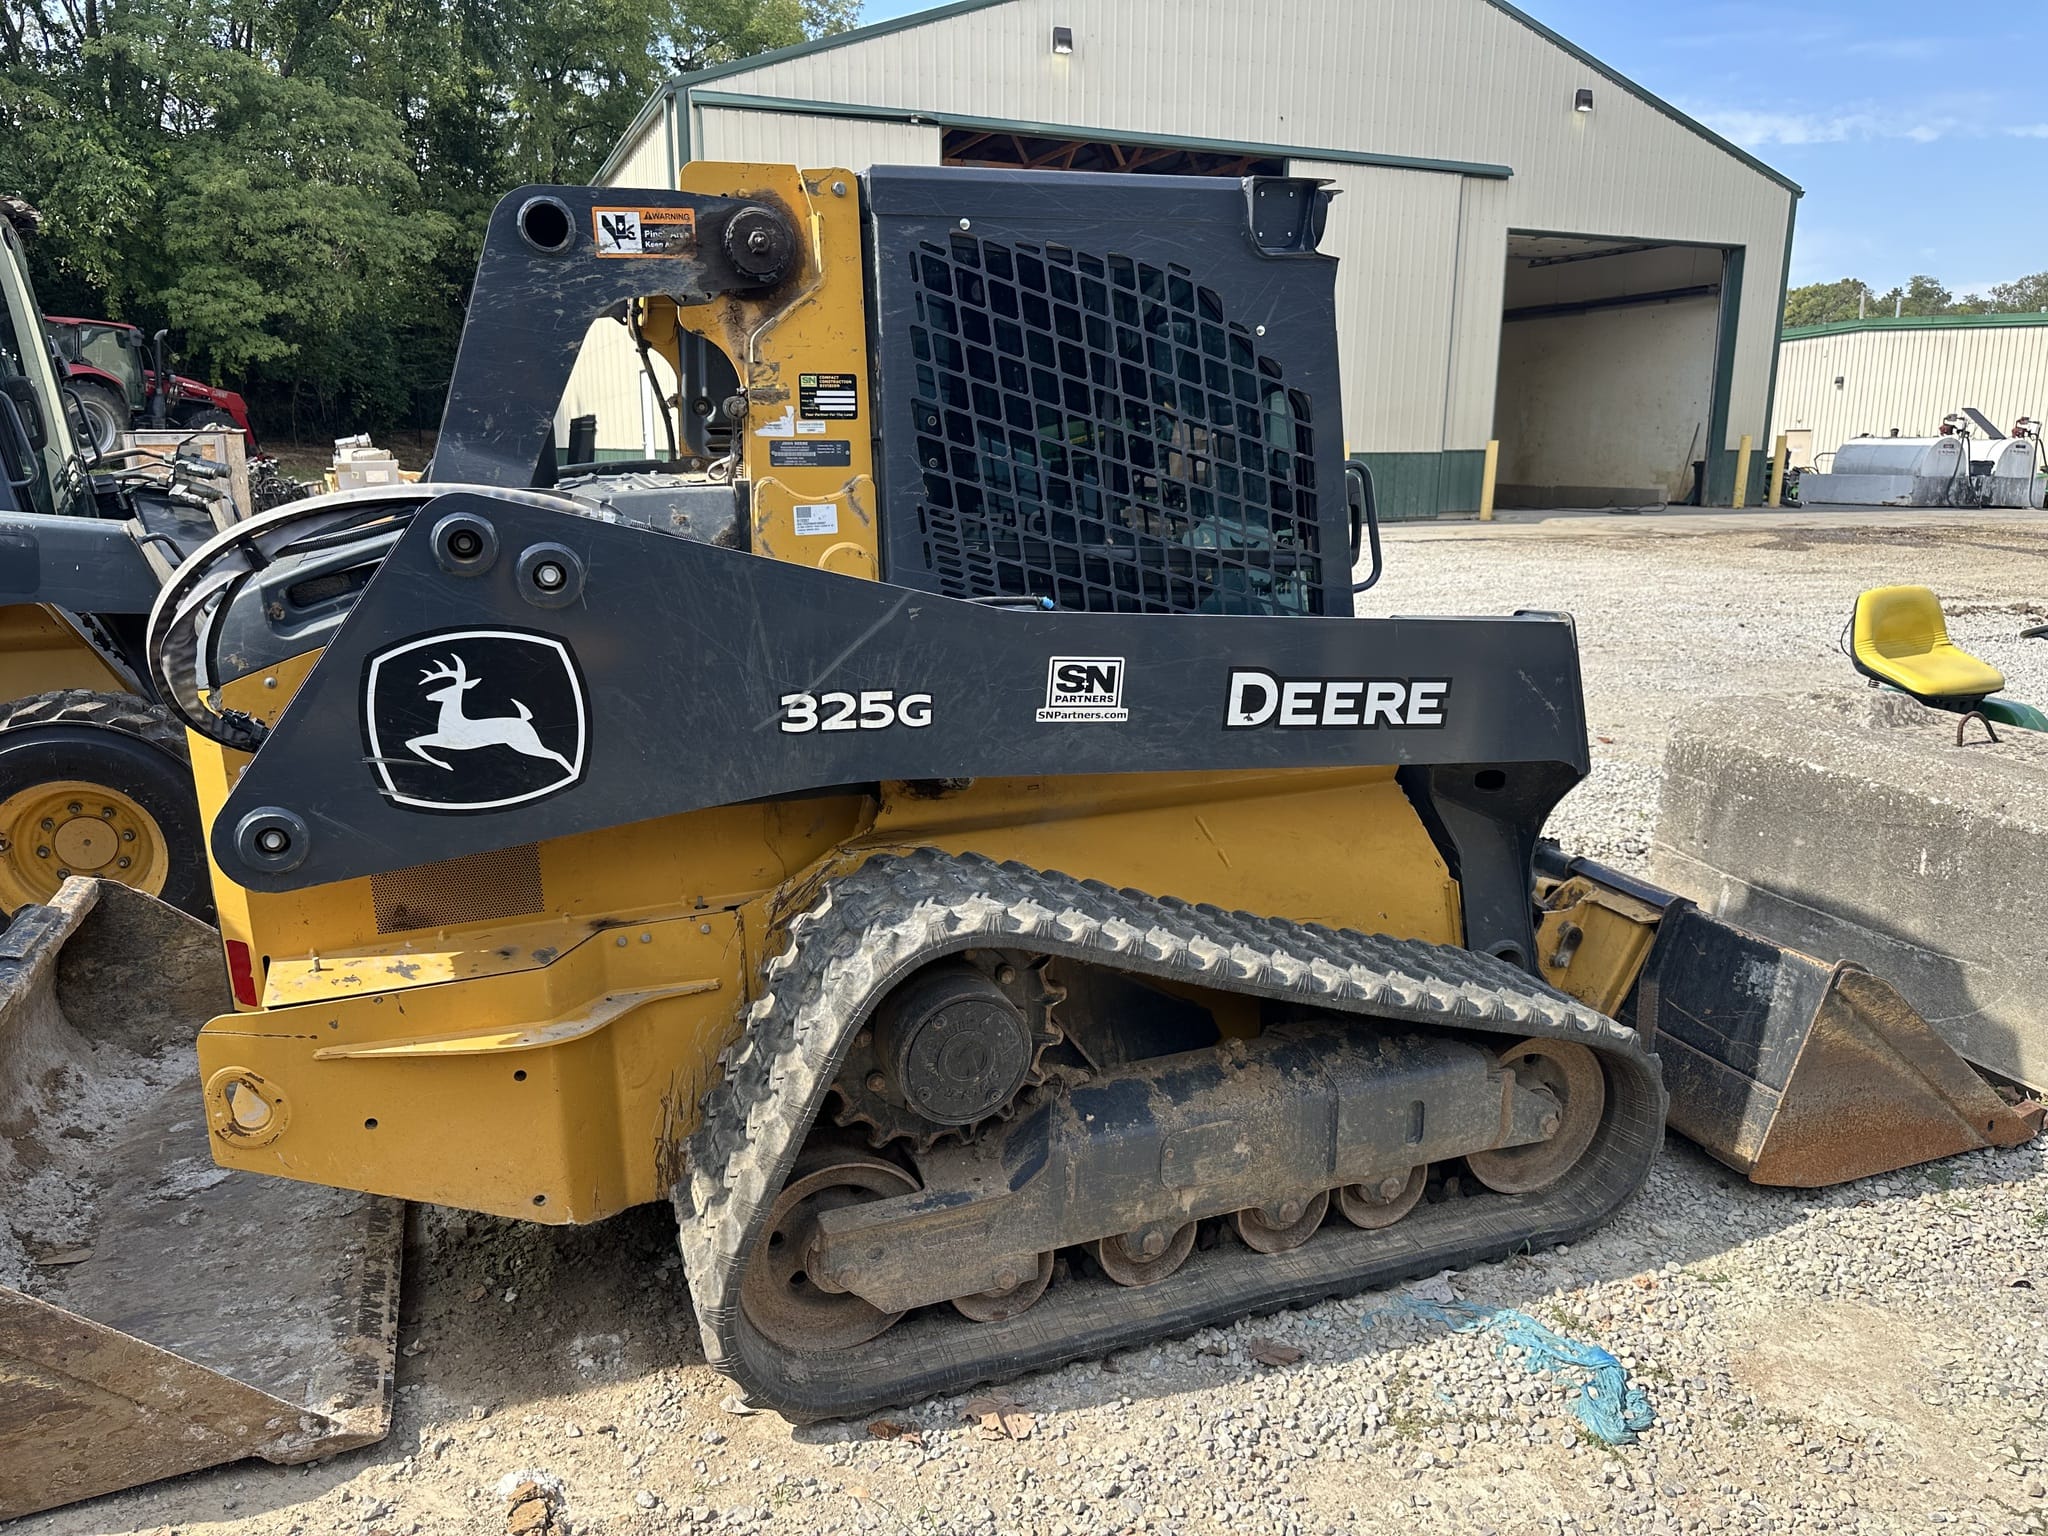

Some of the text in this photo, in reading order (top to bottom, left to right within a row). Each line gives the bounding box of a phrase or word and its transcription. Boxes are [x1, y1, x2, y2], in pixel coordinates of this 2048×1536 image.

[652, 212, 690, 221] WARNING
[1055, 695, 1114, 703] PARTNERS
[1226, 671, 1448, 726] DEERE
[781, 690, 932, 733] 325G
[1038, 711, 1127, 719] SNPartners.com
